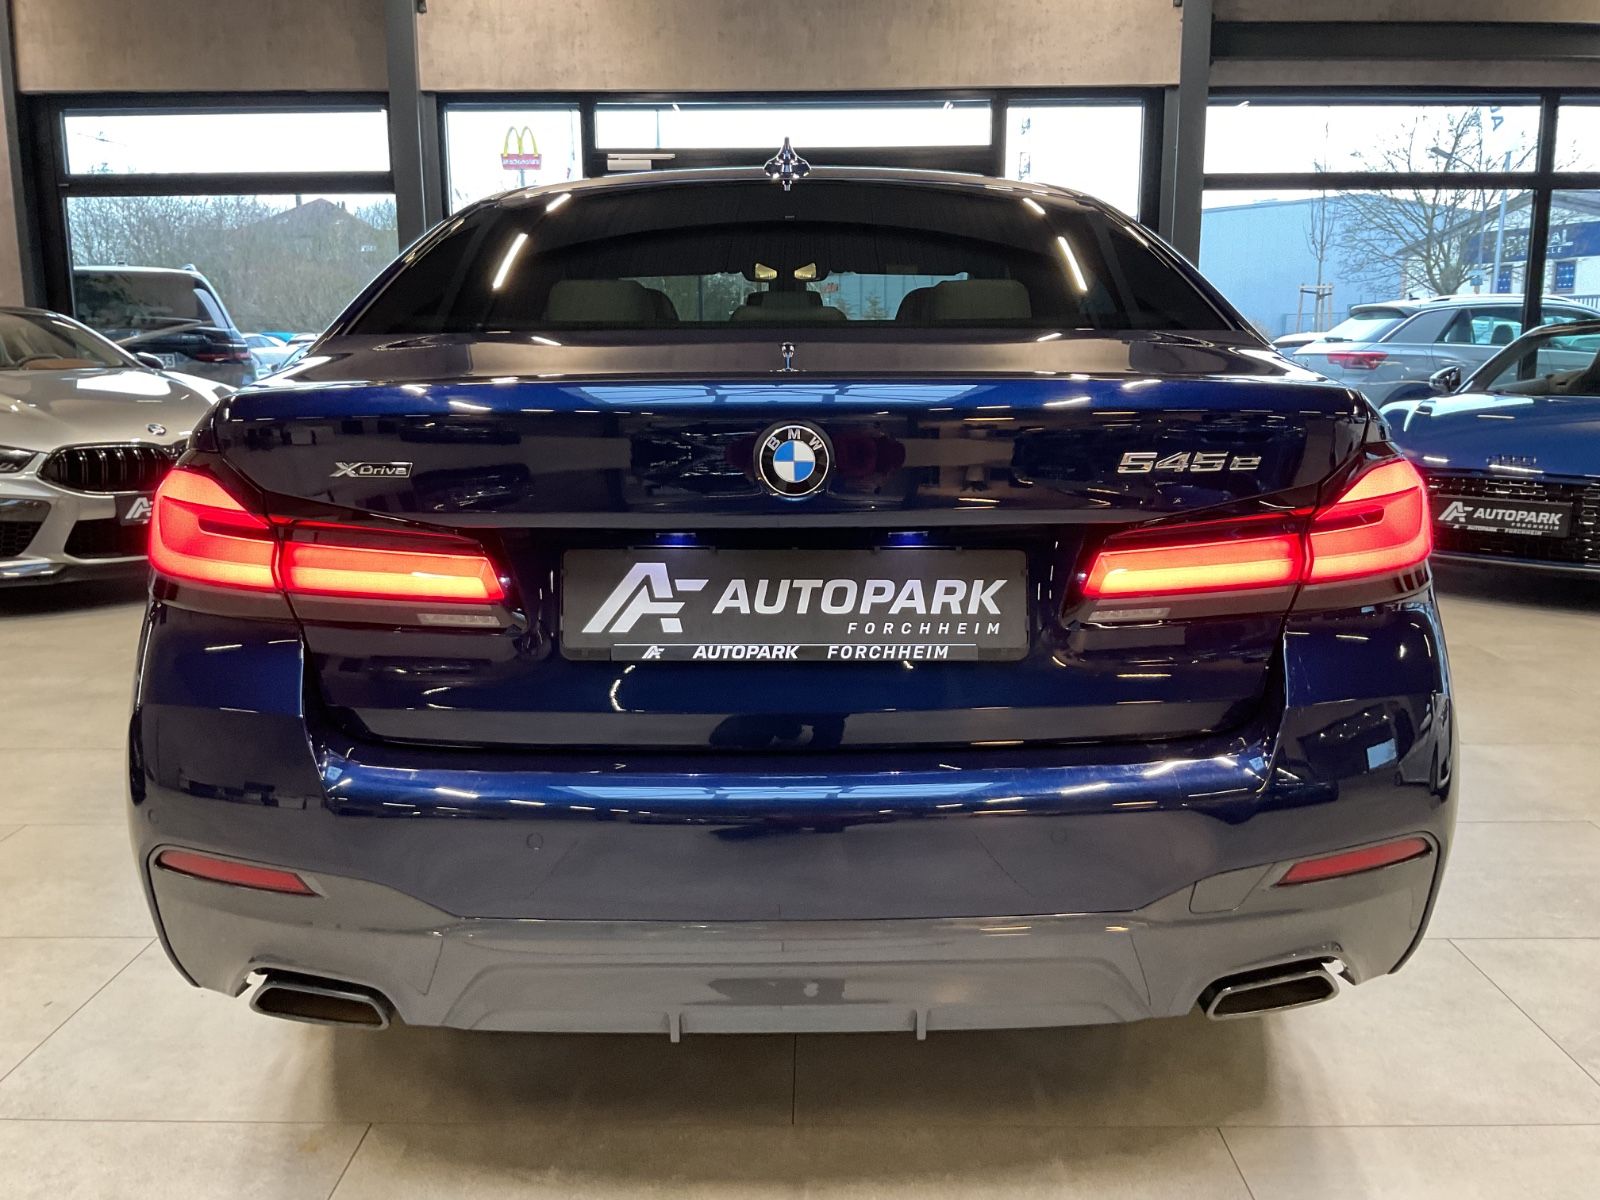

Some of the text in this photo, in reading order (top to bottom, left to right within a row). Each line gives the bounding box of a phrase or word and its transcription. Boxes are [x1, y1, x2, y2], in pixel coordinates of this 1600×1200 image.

[767, 428, 822, 451] BMW
[1117, 451, 1262, 474] 545e
[1473, 507, 1563, 525] AUTOPARK
[712, 579, 1008, 615] AUTOPARK
[847, 622, 1001, 635] FORCHHEIM
[692, 645, 799, 659] AUTOPARK
[827, 645, 949, 660] FORCHHEIM
